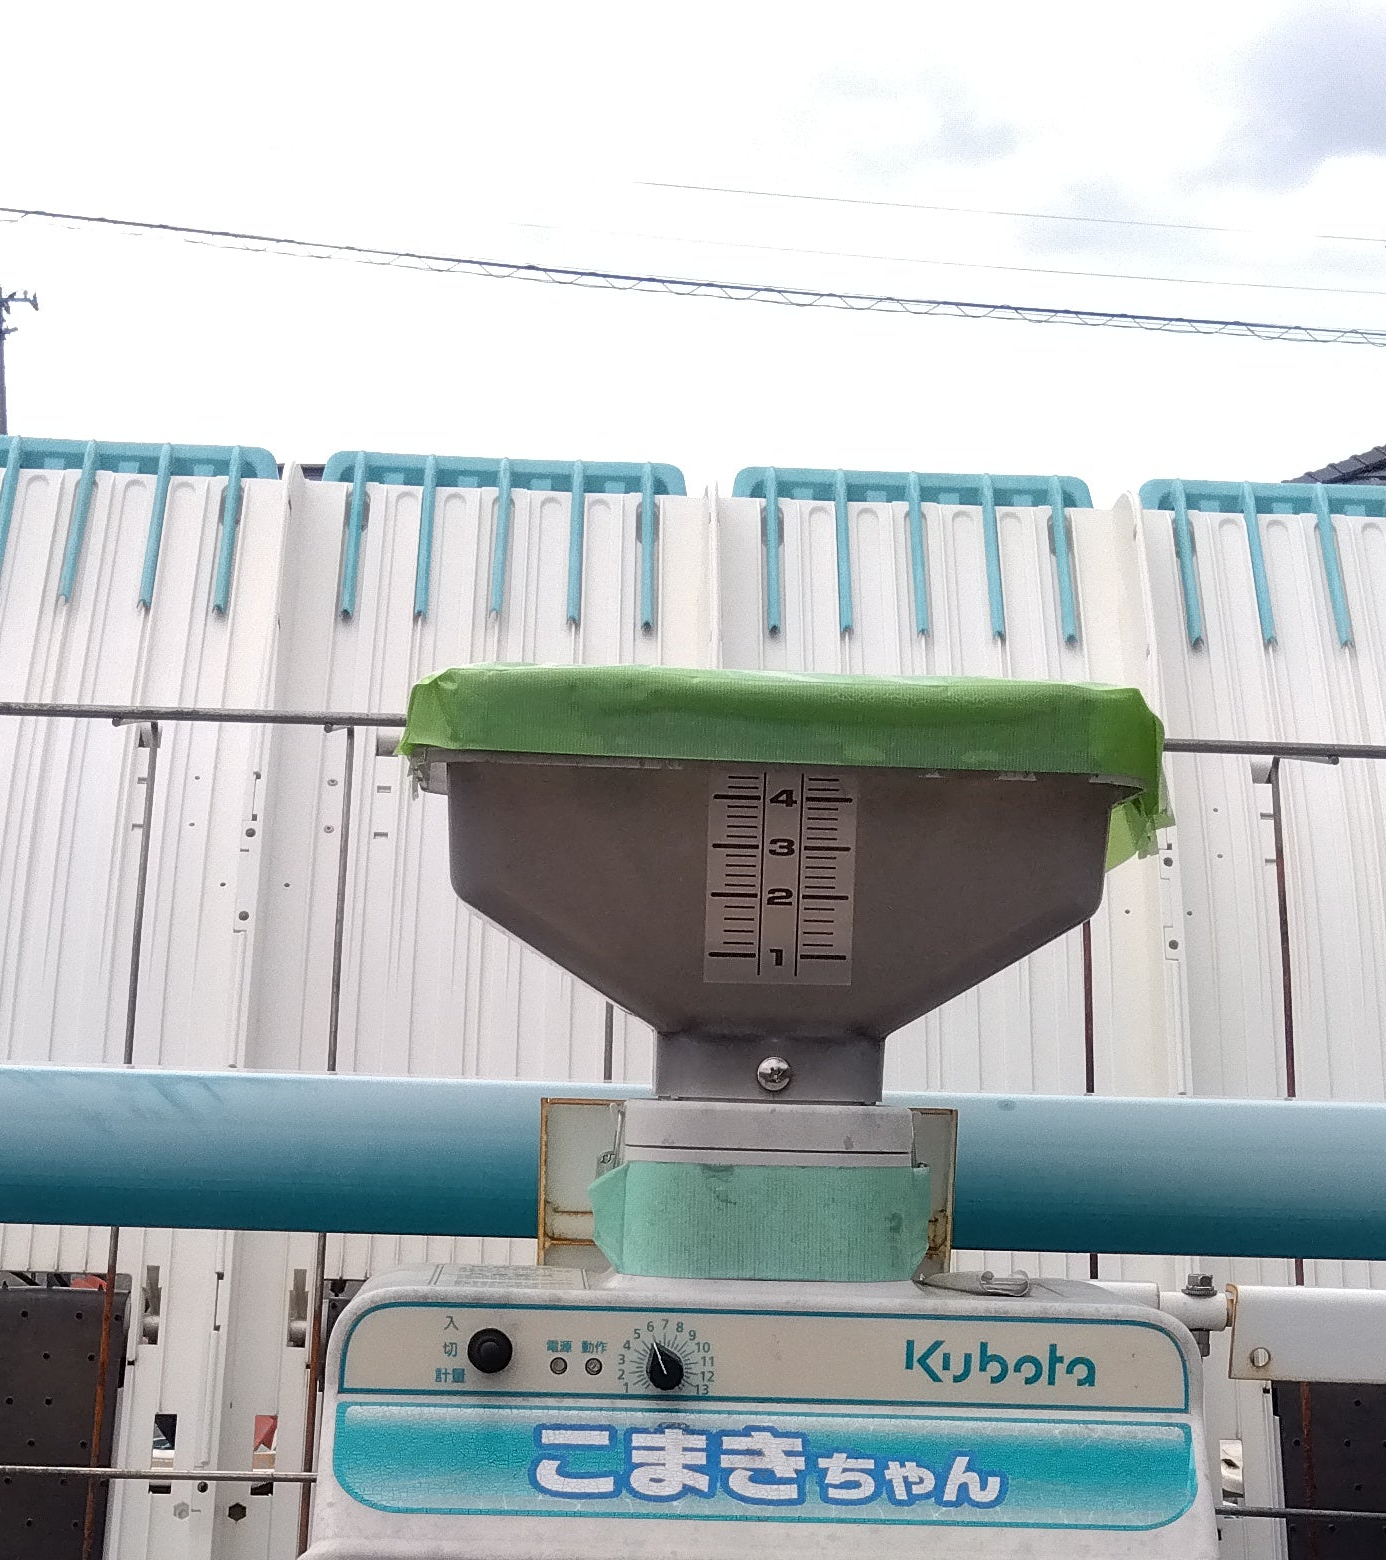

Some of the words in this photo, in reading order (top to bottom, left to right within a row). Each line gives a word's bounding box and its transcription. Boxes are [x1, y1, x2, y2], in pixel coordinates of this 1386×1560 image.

[768, 788, 798, 808] 4
[768, 838, 795, 857] 3
[767, 887, 794, 907] 2
[769, 948, 785, 967] 1
[443, 1315, 459, 1331] 入
[646, 1321, 655, 1332] 6
[662, 1318, 669, 1330] 7
[676, 1321, 684, 1333] 8
[633, 1328, 641, 1340] 5
[688, 1329, 696, 1341] 9
[443, 1341, 458, 1358] 切
[546, 1339, 573, 1354] 電源
[580, 1340, 608, 1355] 動作
[623, 1340, 631, 1351] 4
[695, 1341, 711, 1353] 10
[618, 1354, 626, 1365] 3
[700, 1356, 715, 1367] 11
[904, 1338, 1096, 1389] Kubota
[435, 1367, 465, 1384] 計量
[617, 1369, 625, 1380] 2
[700, 1370, 715, 1383] 12
[623, 1382, 629, 1394] 1
[695, 1384, 710, 1395] 13
[528, 1422, 1010, 1509] こまきちゃん
